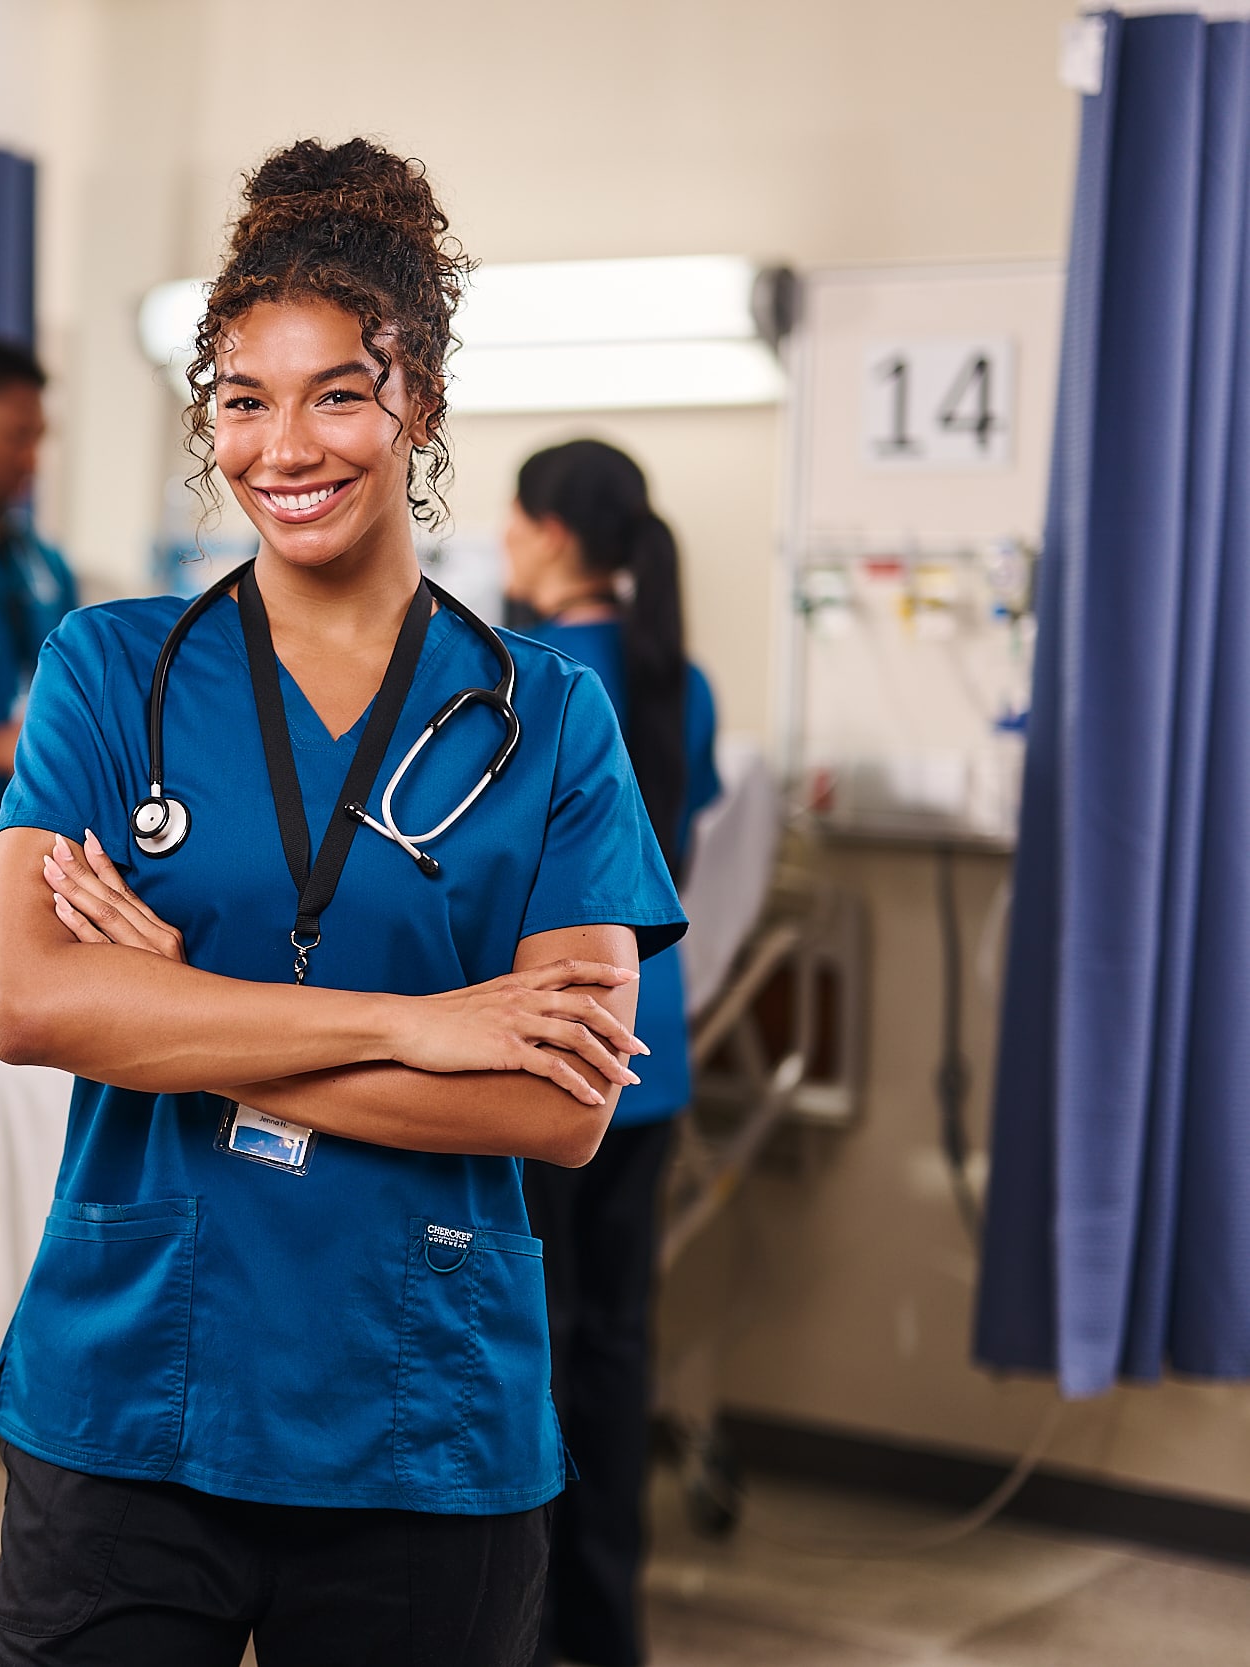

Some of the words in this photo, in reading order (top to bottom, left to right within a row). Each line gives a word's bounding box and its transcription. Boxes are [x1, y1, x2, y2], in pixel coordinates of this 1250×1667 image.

[872, 354, 1008, 459] 14
[259, 1115, 280, 1126] Jenna
[427, 1224, 472, 1242] CHEROKEE
[428, 1236, 468, 1249] WORKWEAR
